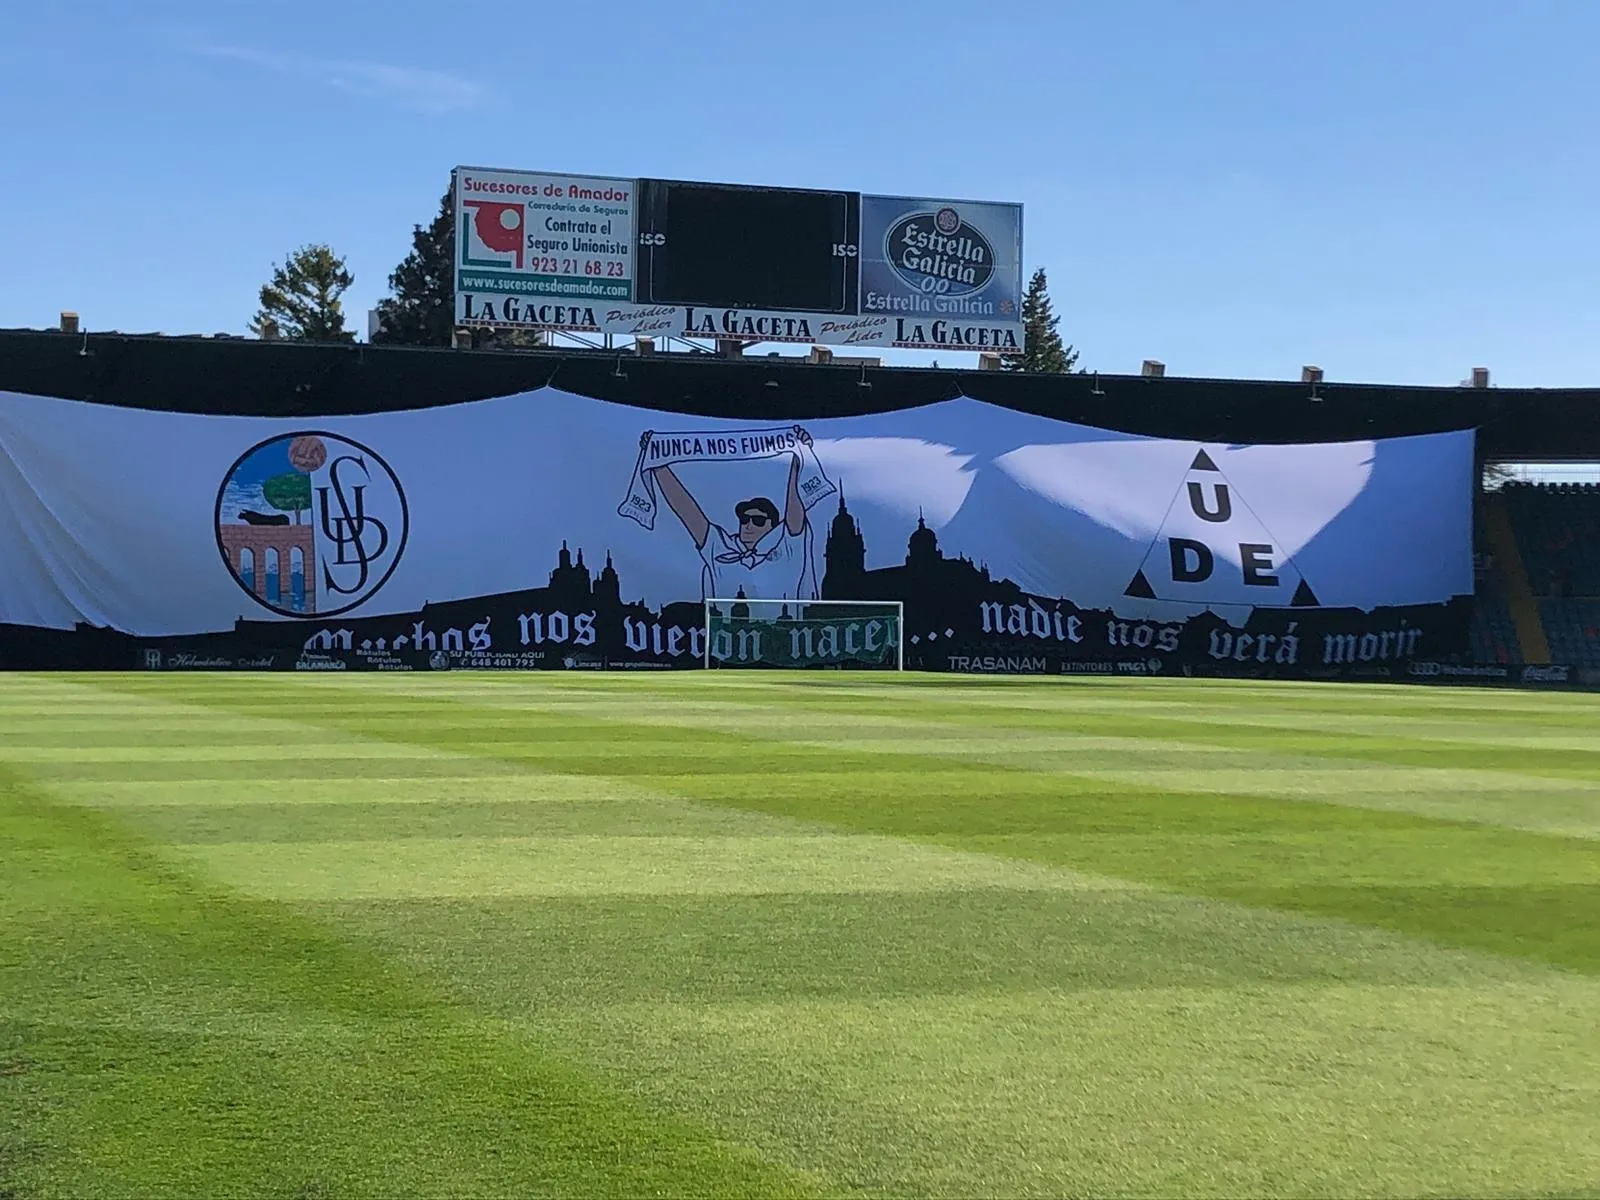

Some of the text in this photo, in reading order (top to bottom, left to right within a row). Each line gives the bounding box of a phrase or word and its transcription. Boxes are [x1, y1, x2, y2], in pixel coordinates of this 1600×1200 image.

[464, 177, 629, 201] Sucesores de Amador
[528, 200, 628, 216] Correduría de Seguros
[545, 217, 611, 235] Contrata el
[527, 235, 628, 255] Seguro Unionista
[901, 223, 984, 263] Estrella
[532, 257, 624, 277] 923 21 68 23
[902, 247, 976, 284] Galicia
[463, 276, 628, 297] www.sucesoresdeamador.com
[865, 291, 994, 315] Estrella Galicia
[650, 433, 796, 460] NUNCA NOS FUIMOS
[800, 476, 822, 494] 1923
[630, 494, 652, 512] 1923
[1187, 482, 1232, 523] U
[517, 610, 596, 646] nos
[979, 598, 1084, 644] nadie
[1106, 620, 1183, 652] nos
[1208, 622, 1300, 664] verá
[1322, 619, 1424, 664] morir
[450, 650, 462, 658] SU
[471, 658, 492, 666] 648
[494, 658, 512, 666] 401
[948, 656, 1046, 672] TRASANAM
